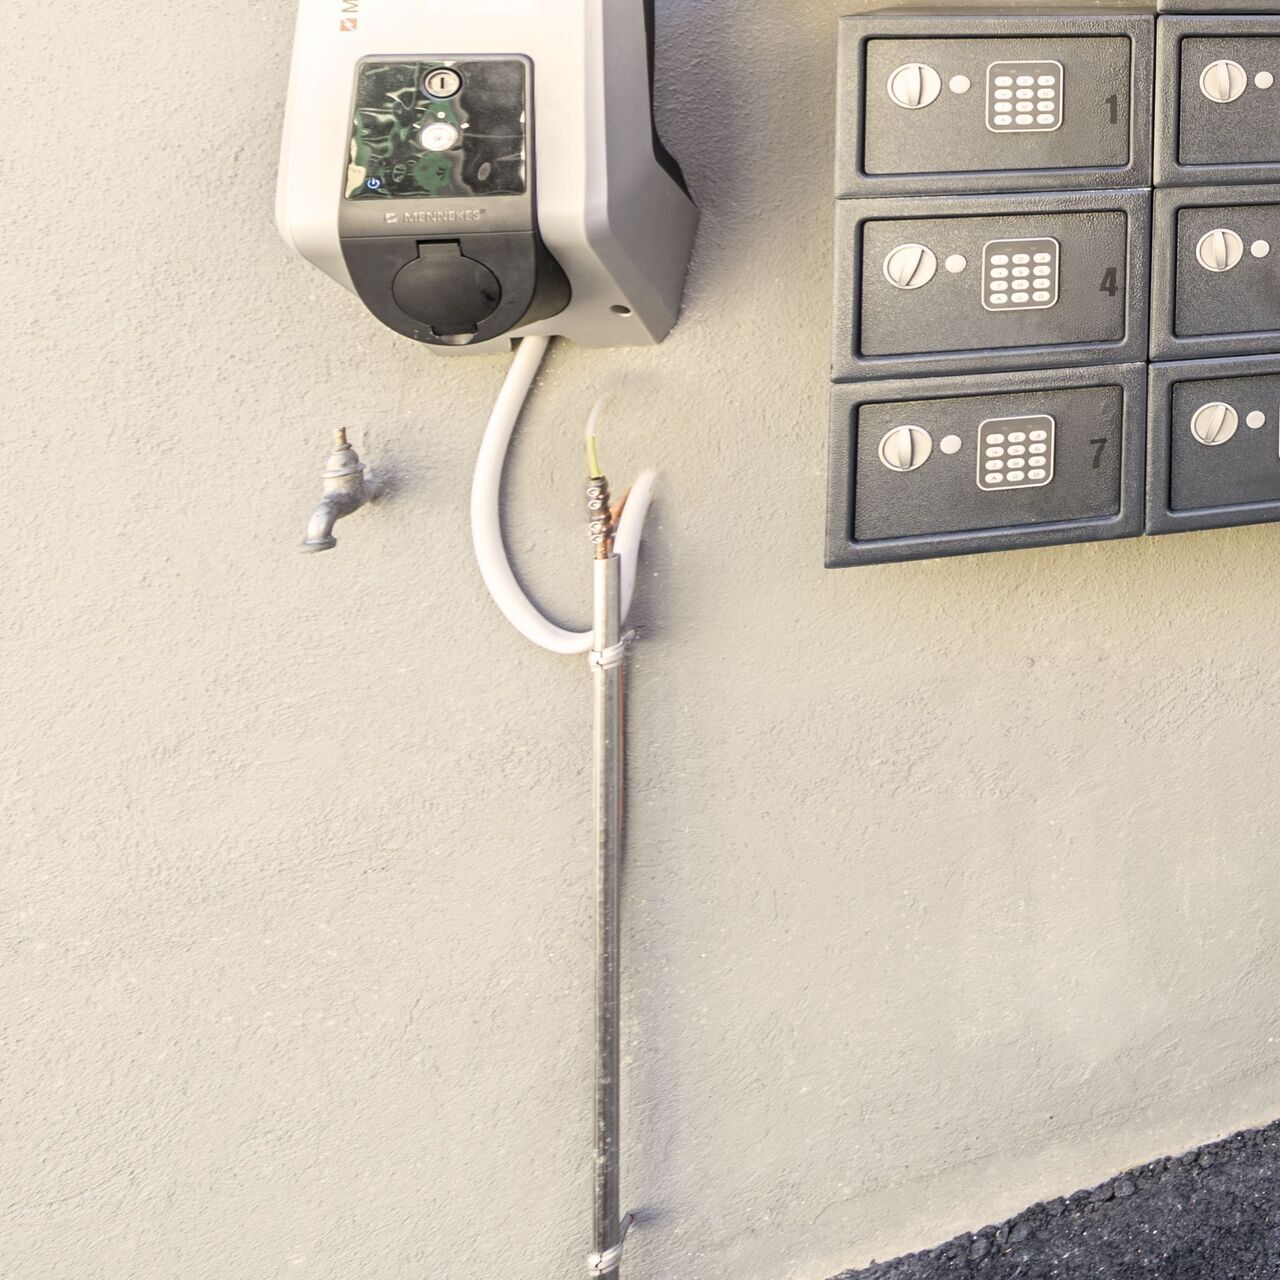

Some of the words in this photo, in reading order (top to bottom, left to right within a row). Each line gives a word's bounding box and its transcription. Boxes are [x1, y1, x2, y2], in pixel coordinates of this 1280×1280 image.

[1105, 95, 1118, 124] 1
[403, 209, 480, 223] MENNEKES
[1100, 267, 1118, 297] 4
[1090, 438, 1107, 469] 7
